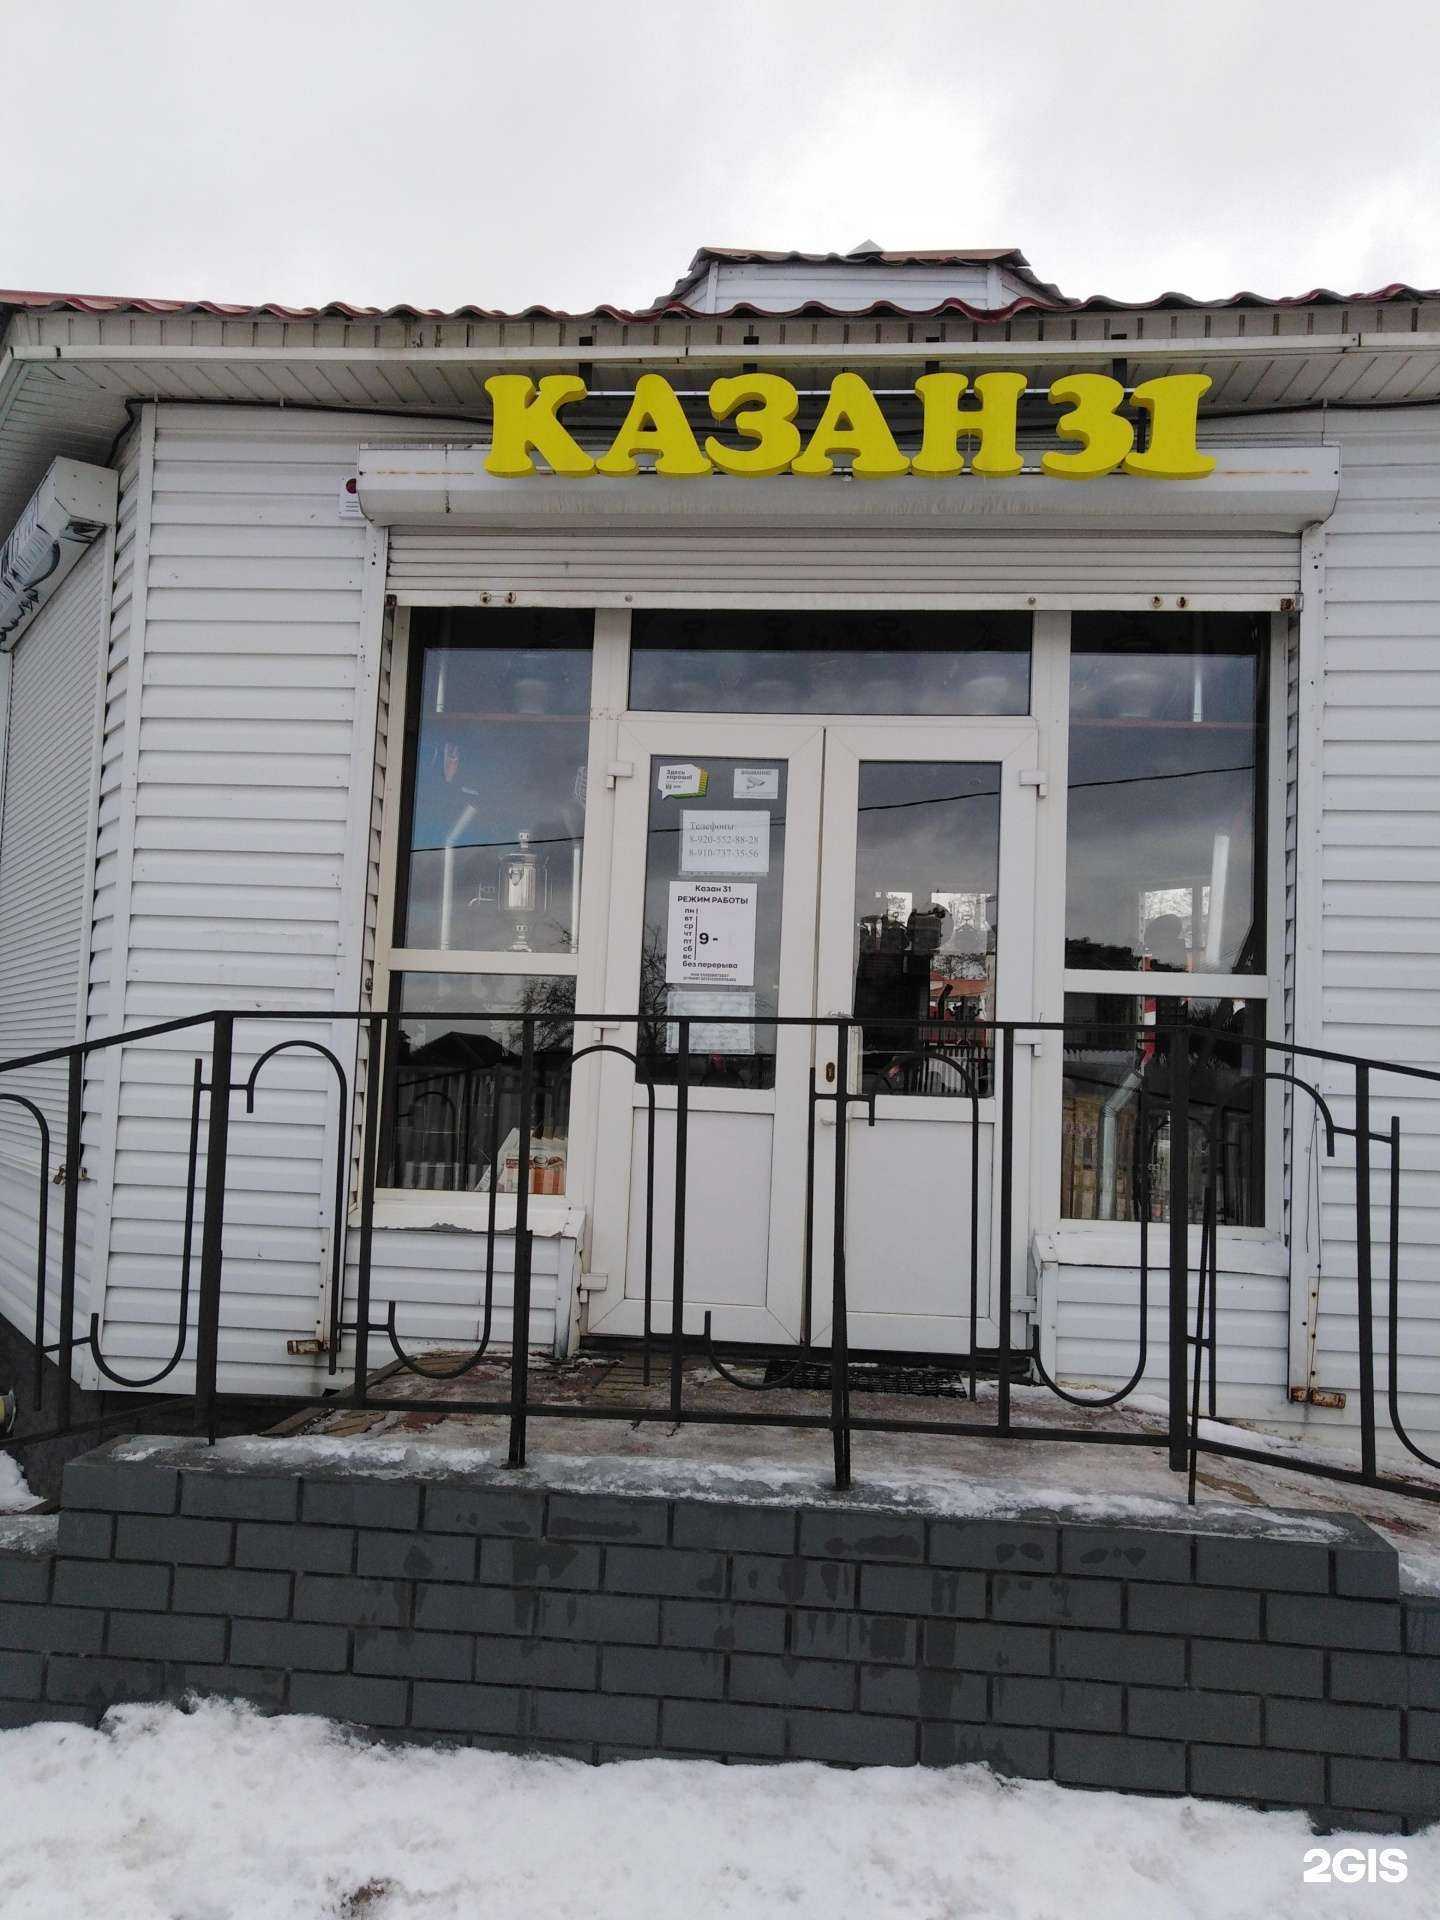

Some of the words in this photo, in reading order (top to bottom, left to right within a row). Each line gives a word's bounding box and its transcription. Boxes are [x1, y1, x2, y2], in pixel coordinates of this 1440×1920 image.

[695, 884, 722, 893] Казан
[723, 885, 732, 893] 31
[677, 895, 711, 904] РЕЖИМ
[711, 896, 749, 905] РАБОТЫ
[682, 960, 697, 968] Без
[697, 961, 738, 970] перерыва
